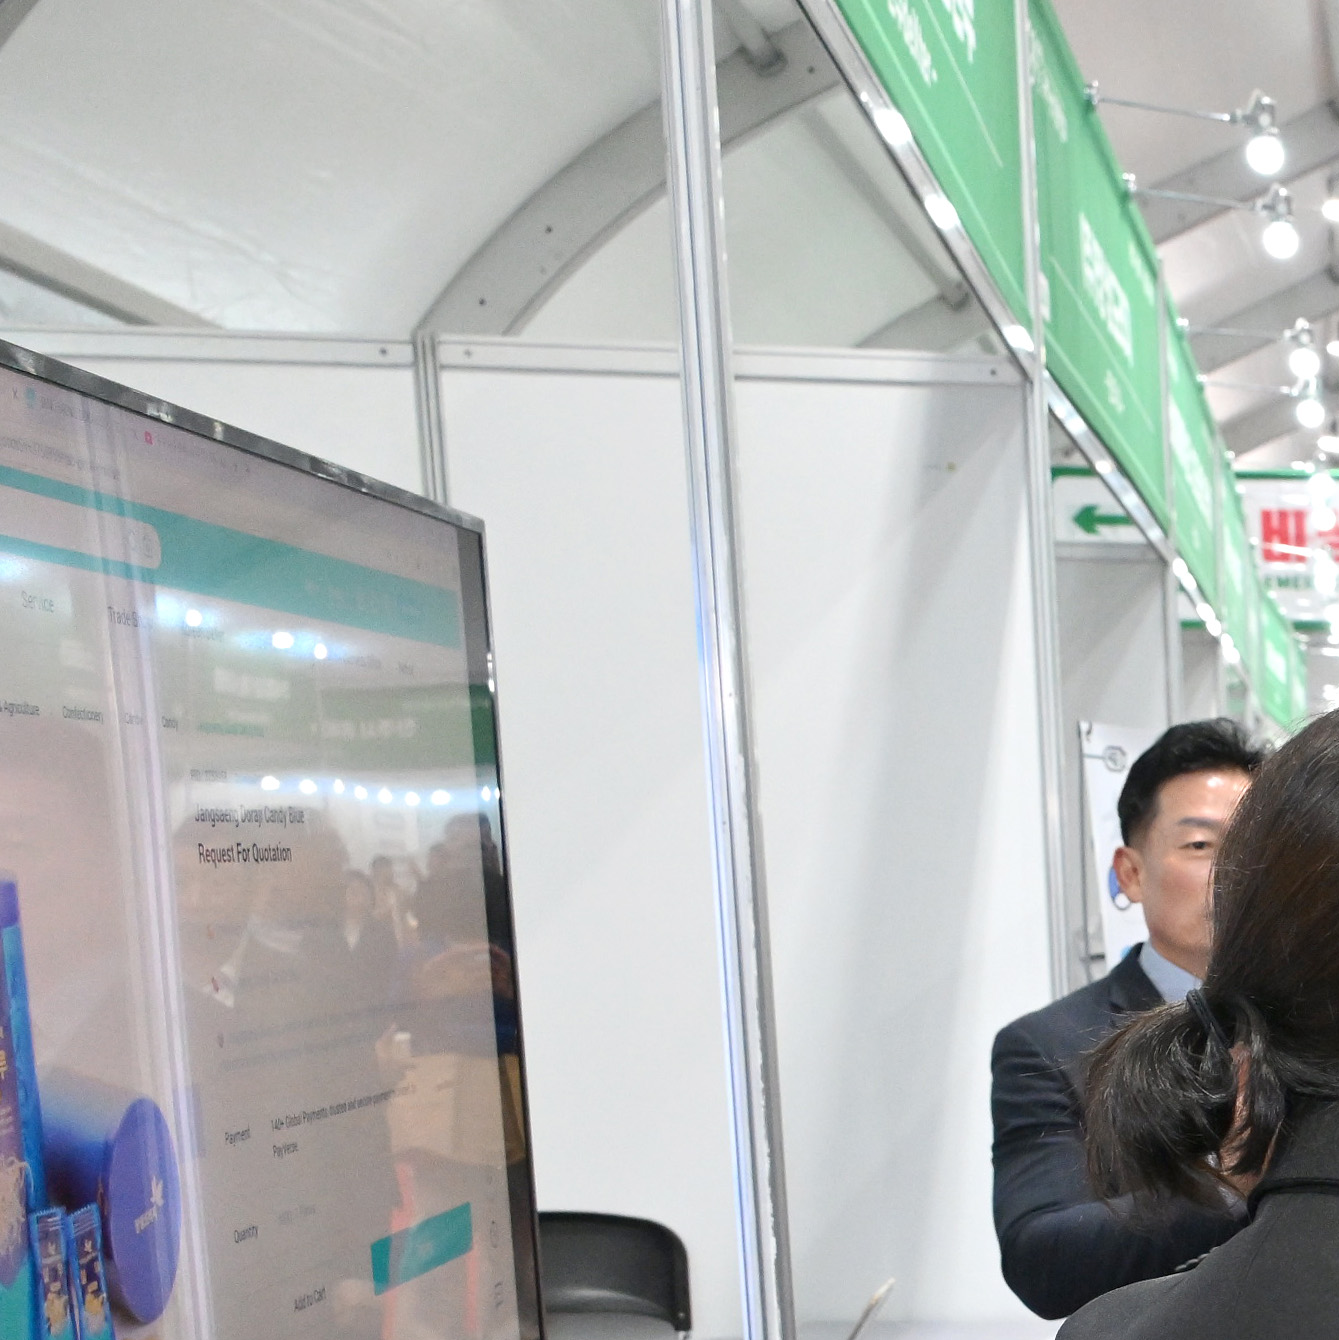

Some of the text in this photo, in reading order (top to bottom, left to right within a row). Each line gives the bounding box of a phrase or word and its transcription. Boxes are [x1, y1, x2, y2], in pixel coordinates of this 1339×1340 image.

[21, 590, 55, 613] Serice
[198, 841, 292, 868] Request For Quotation
